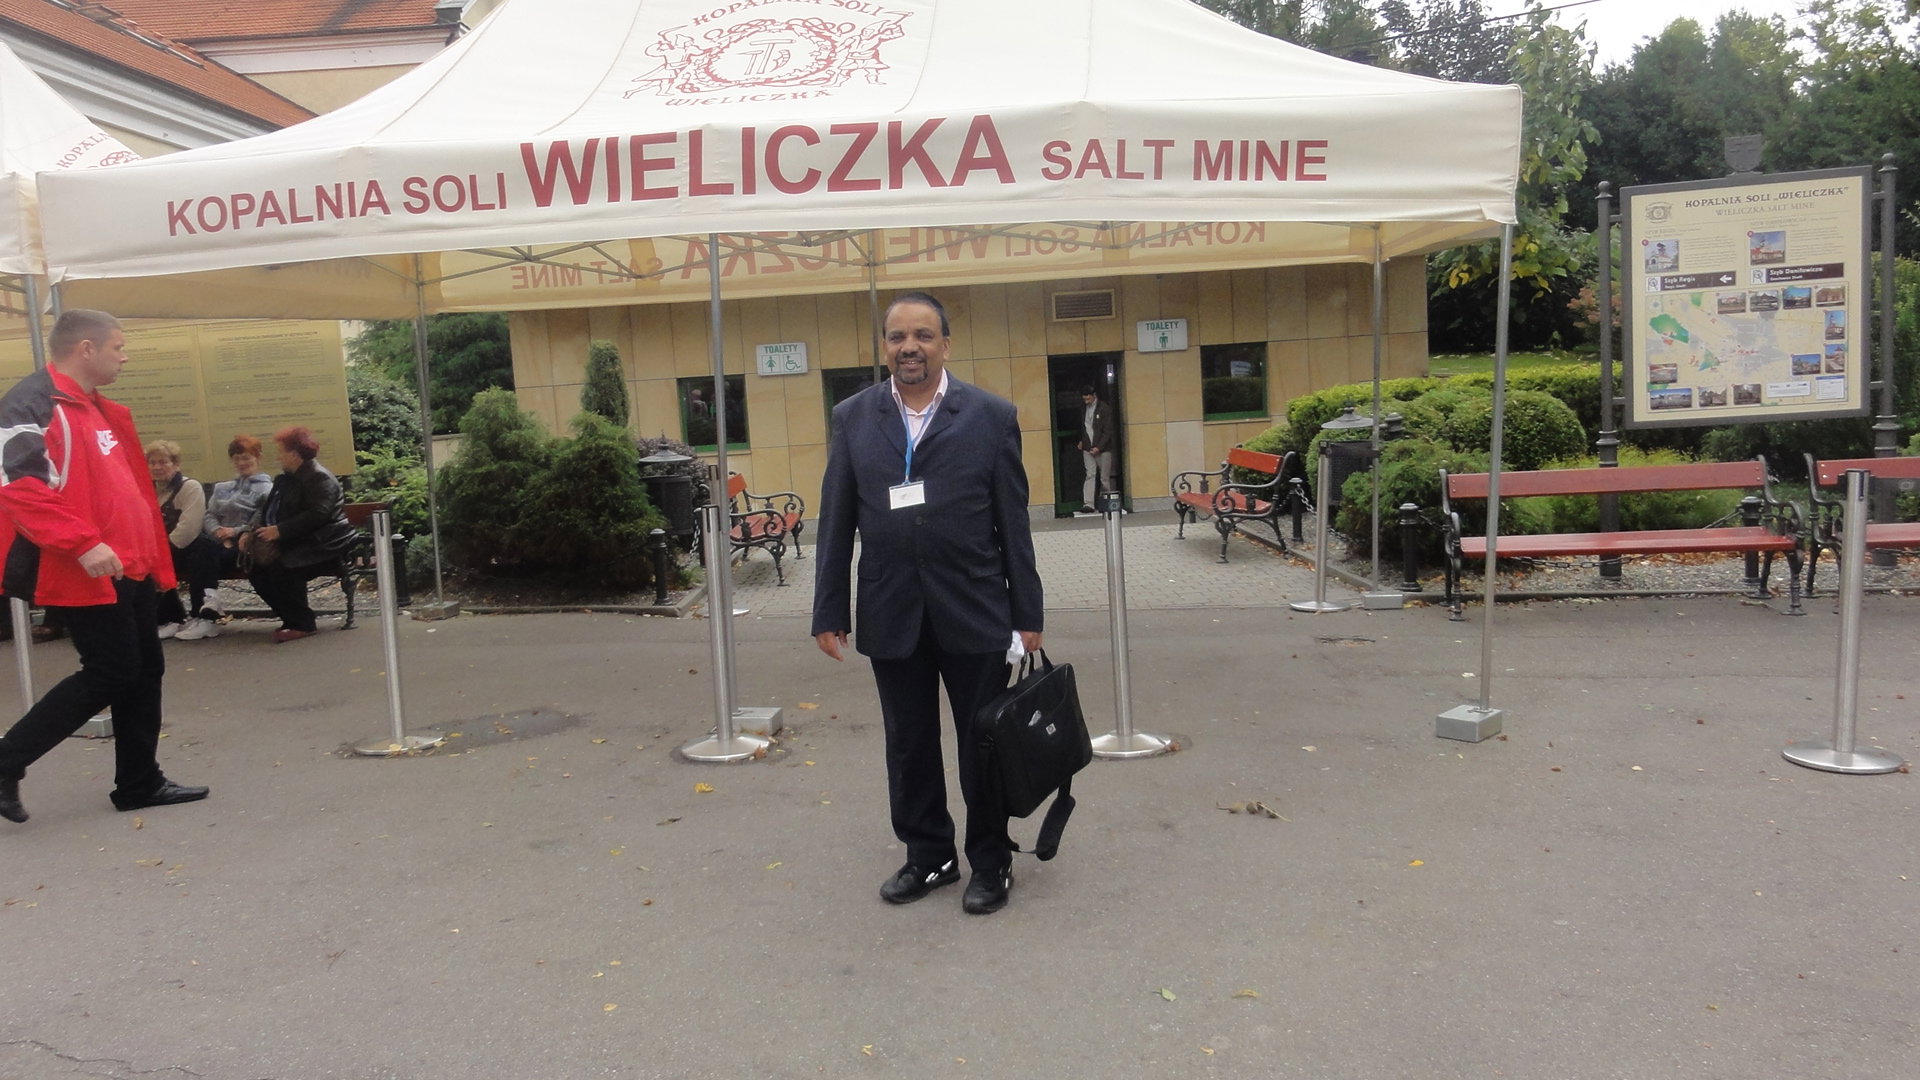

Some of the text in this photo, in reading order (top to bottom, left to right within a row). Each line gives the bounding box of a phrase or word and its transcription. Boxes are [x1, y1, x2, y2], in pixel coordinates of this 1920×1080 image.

[829, 0, 884, 17] SOLI
[665, 89, 834, 106] WIELICZKA
[167, 114, 1328, 237] KOPALNIA SOLI WIELICZKA SALT MINE
[1685, 196, 1742, 208] KOPALNIA
[1746, 194, 1770, 203] SOLI
[1715, 206, 1765, 216] WIELICZKA
[1791, 201, 1816, 210] MINE
[1145, 321, 1180, 331] TOALETY
[764, 344, 798, 354] TOALETY
